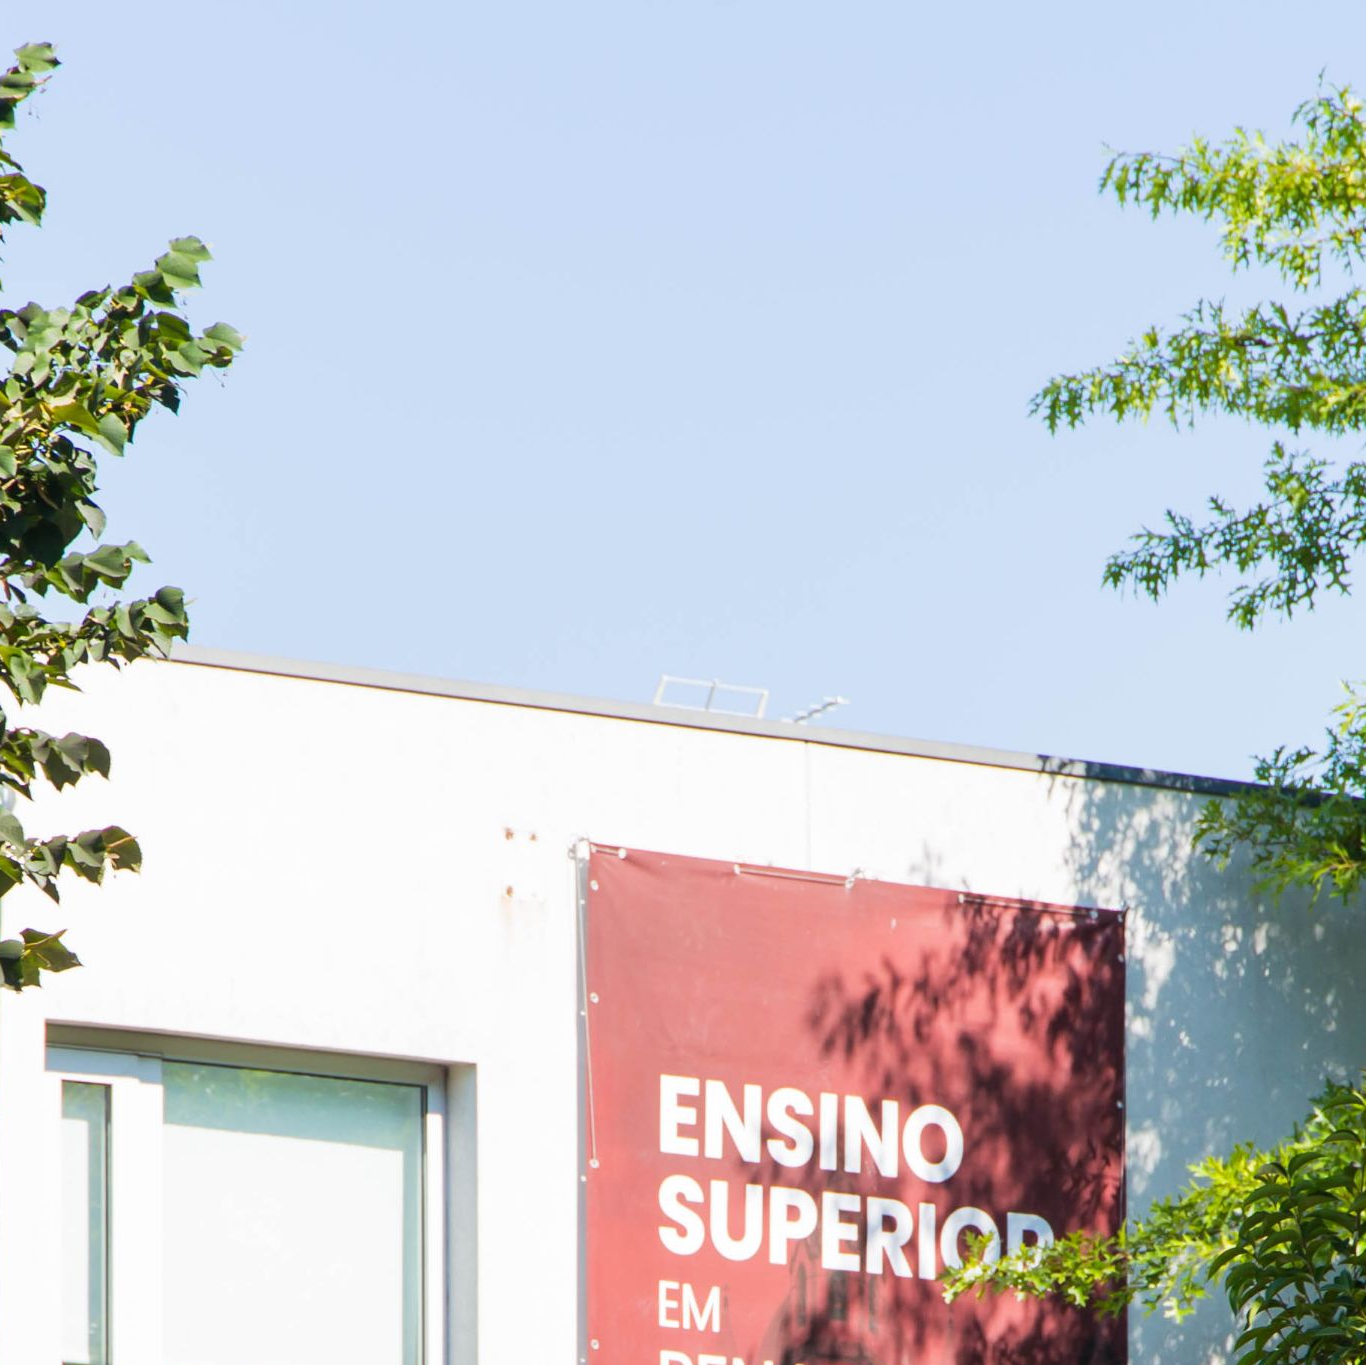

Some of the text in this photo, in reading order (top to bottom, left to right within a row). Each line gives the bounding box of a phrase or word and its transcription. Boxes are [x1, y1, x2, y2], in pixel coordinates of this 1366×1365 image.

[659, 1074, 963, 1183] ENSINO
[658, 1175, 1054, 1283] SUPERIOR
[658, 1280, 721, 1333] EM
